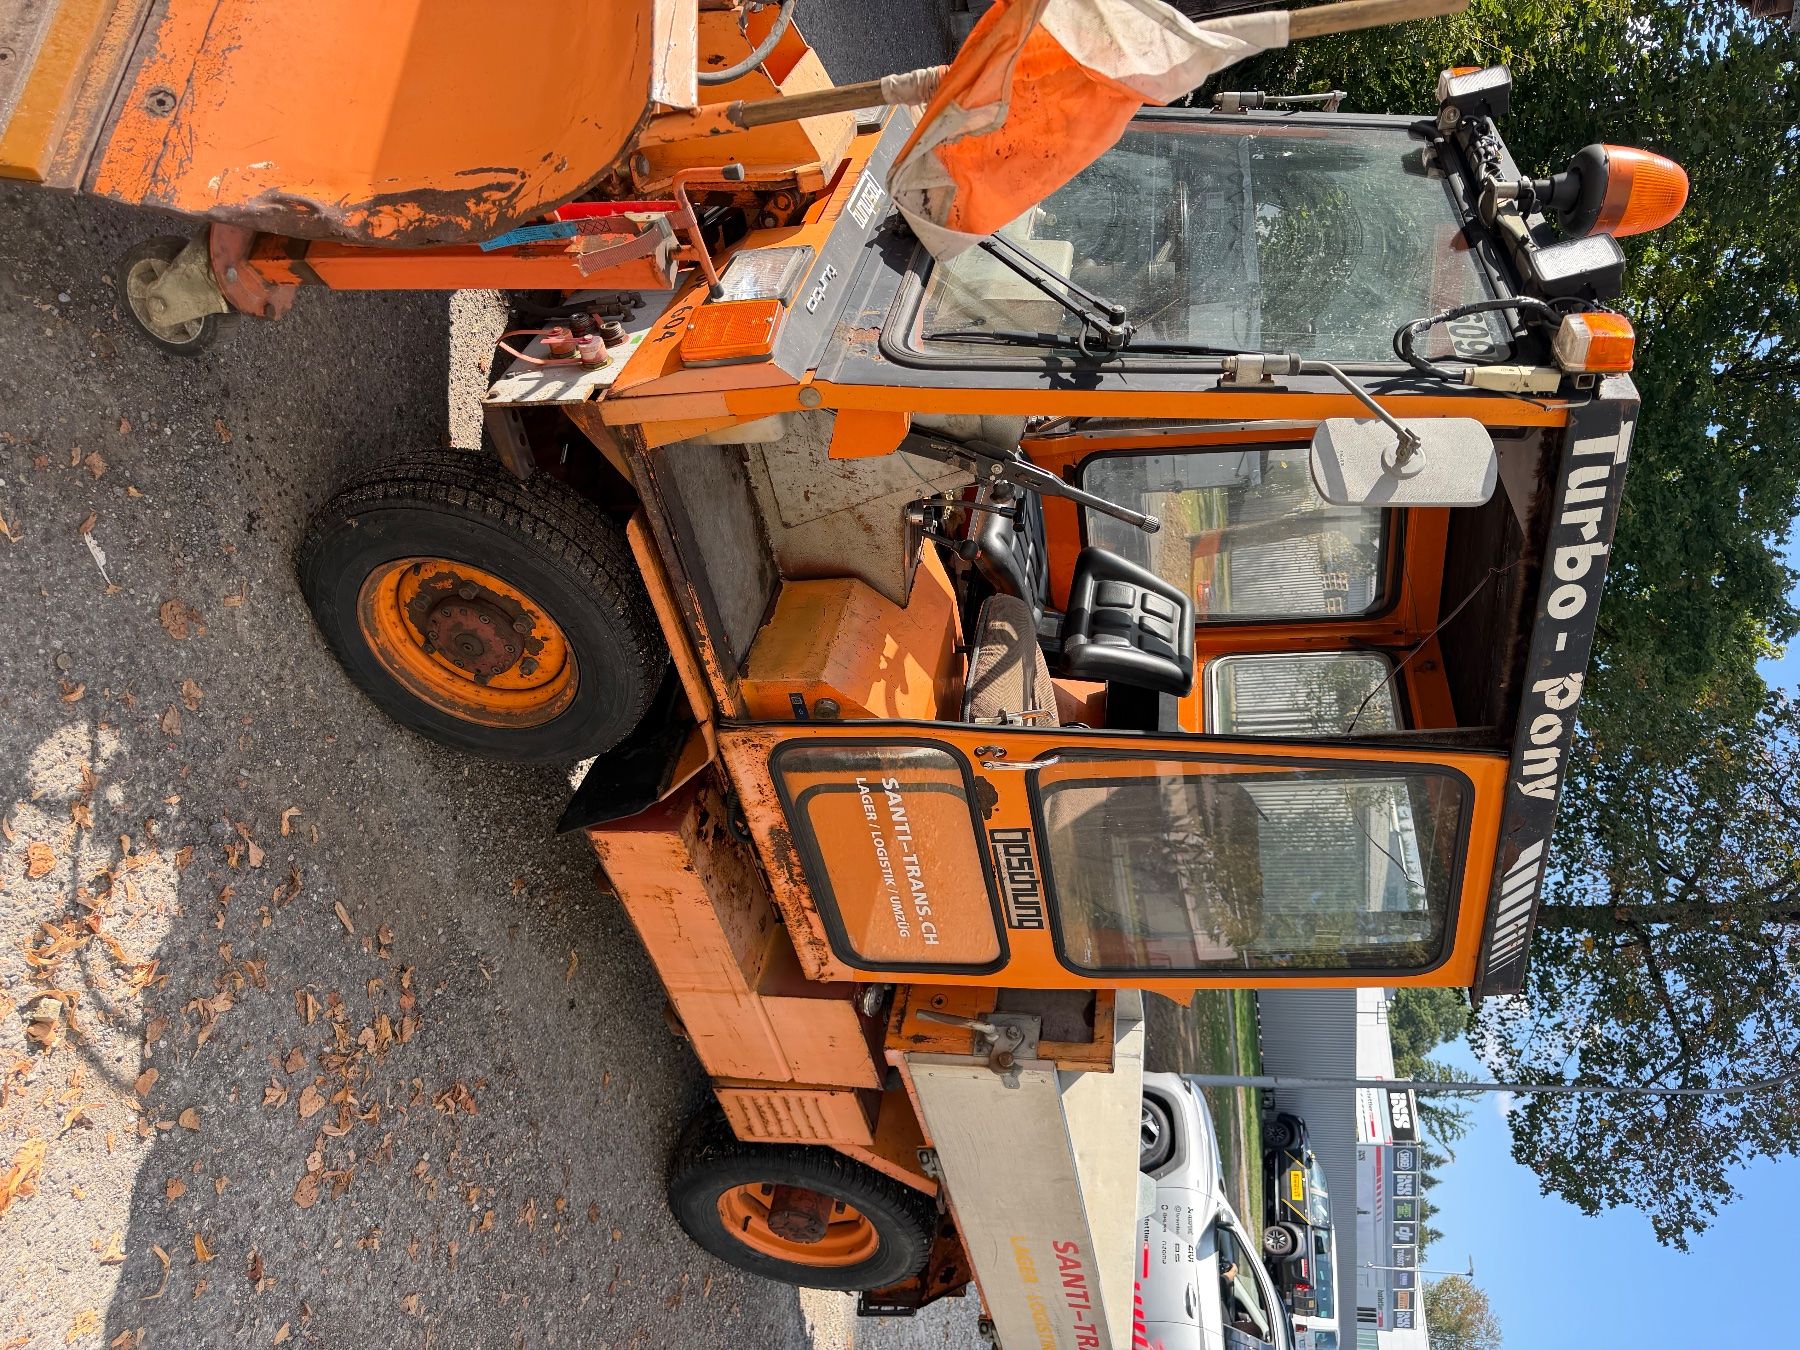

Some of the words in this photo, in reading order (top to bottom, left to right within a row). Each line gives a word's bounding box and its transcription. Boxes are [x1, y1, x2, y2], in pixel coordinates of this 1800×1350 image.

[806, 264, 838, 314] turbo
[1547, 420, 1633, 621] Turbo
[1515, 672, 1584, 801] Pony
[855, 777, 878, 821] LAGER
[870, 831, 896, 886] LOGISTIK
[881, 777, 939, 945] SANTI-TRANS.CH
[1052, 1240, 1100, 1350] SANTI-TR
